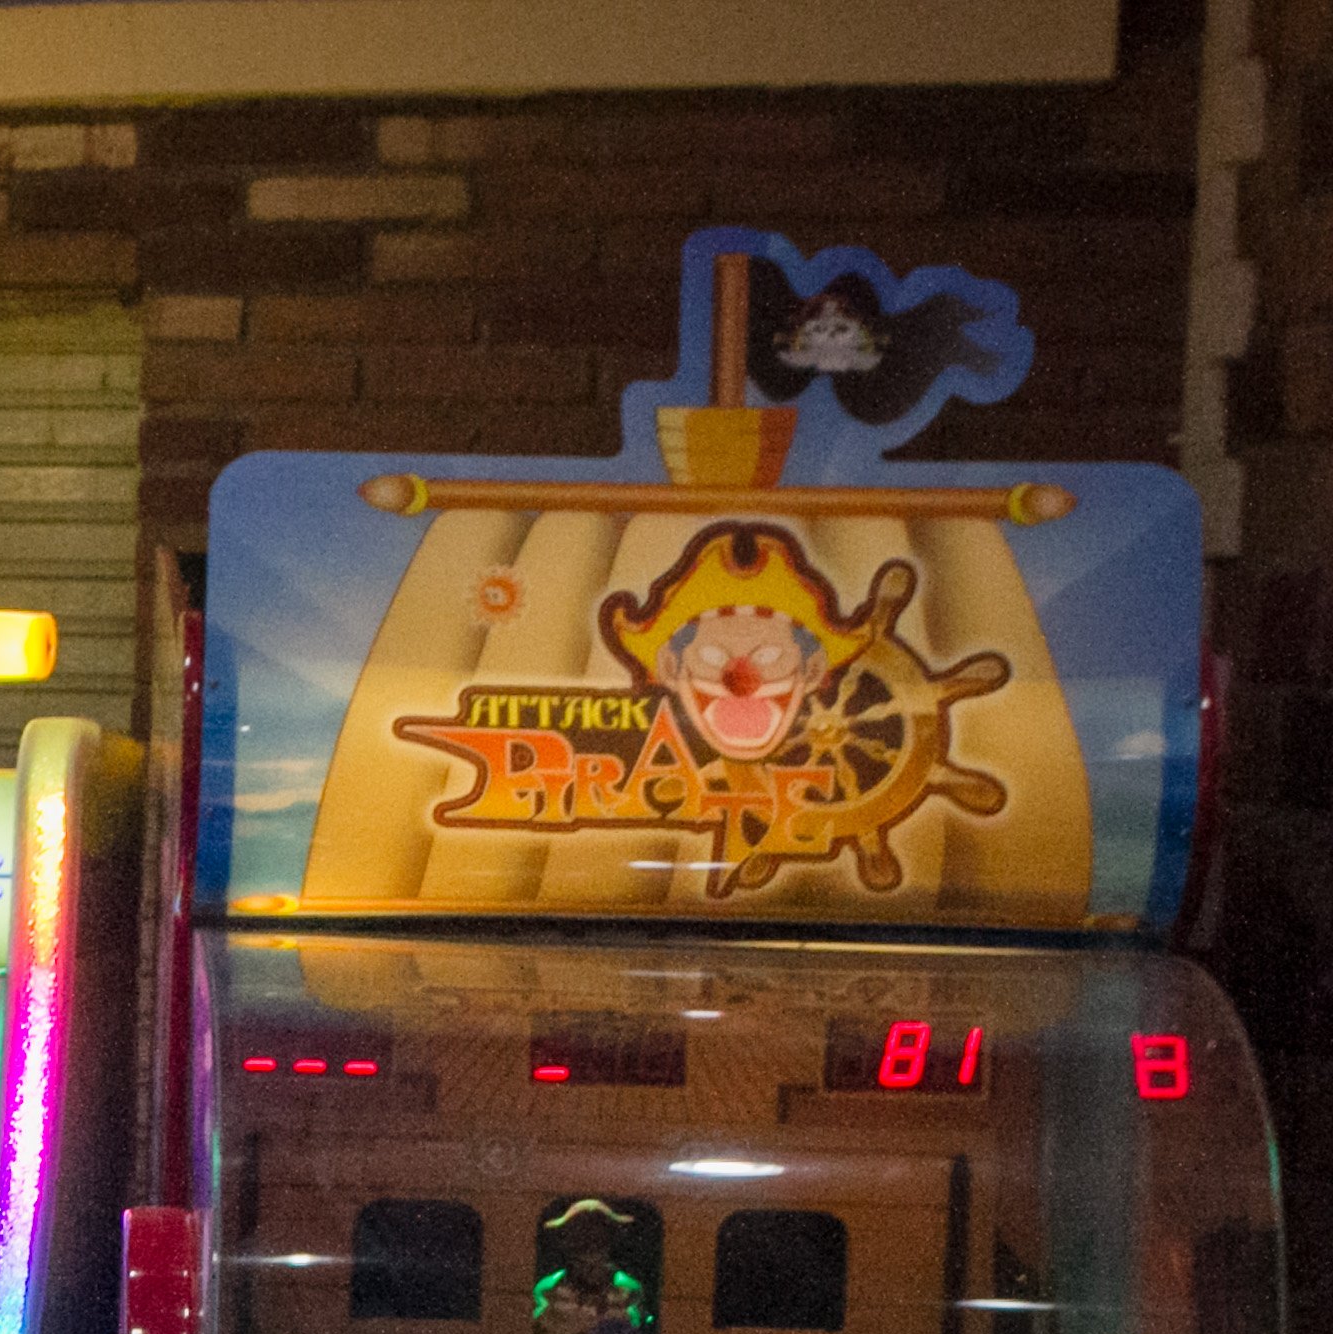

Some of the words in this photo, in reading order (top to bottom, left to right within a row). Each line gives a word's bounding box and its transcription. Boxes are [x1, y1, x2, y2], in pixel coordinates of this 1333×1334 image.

[467, 695, 653, 730] ATTACK
[405, 697, 833, 875] PIRATE
[877, 1019, 984, 1089] 81
